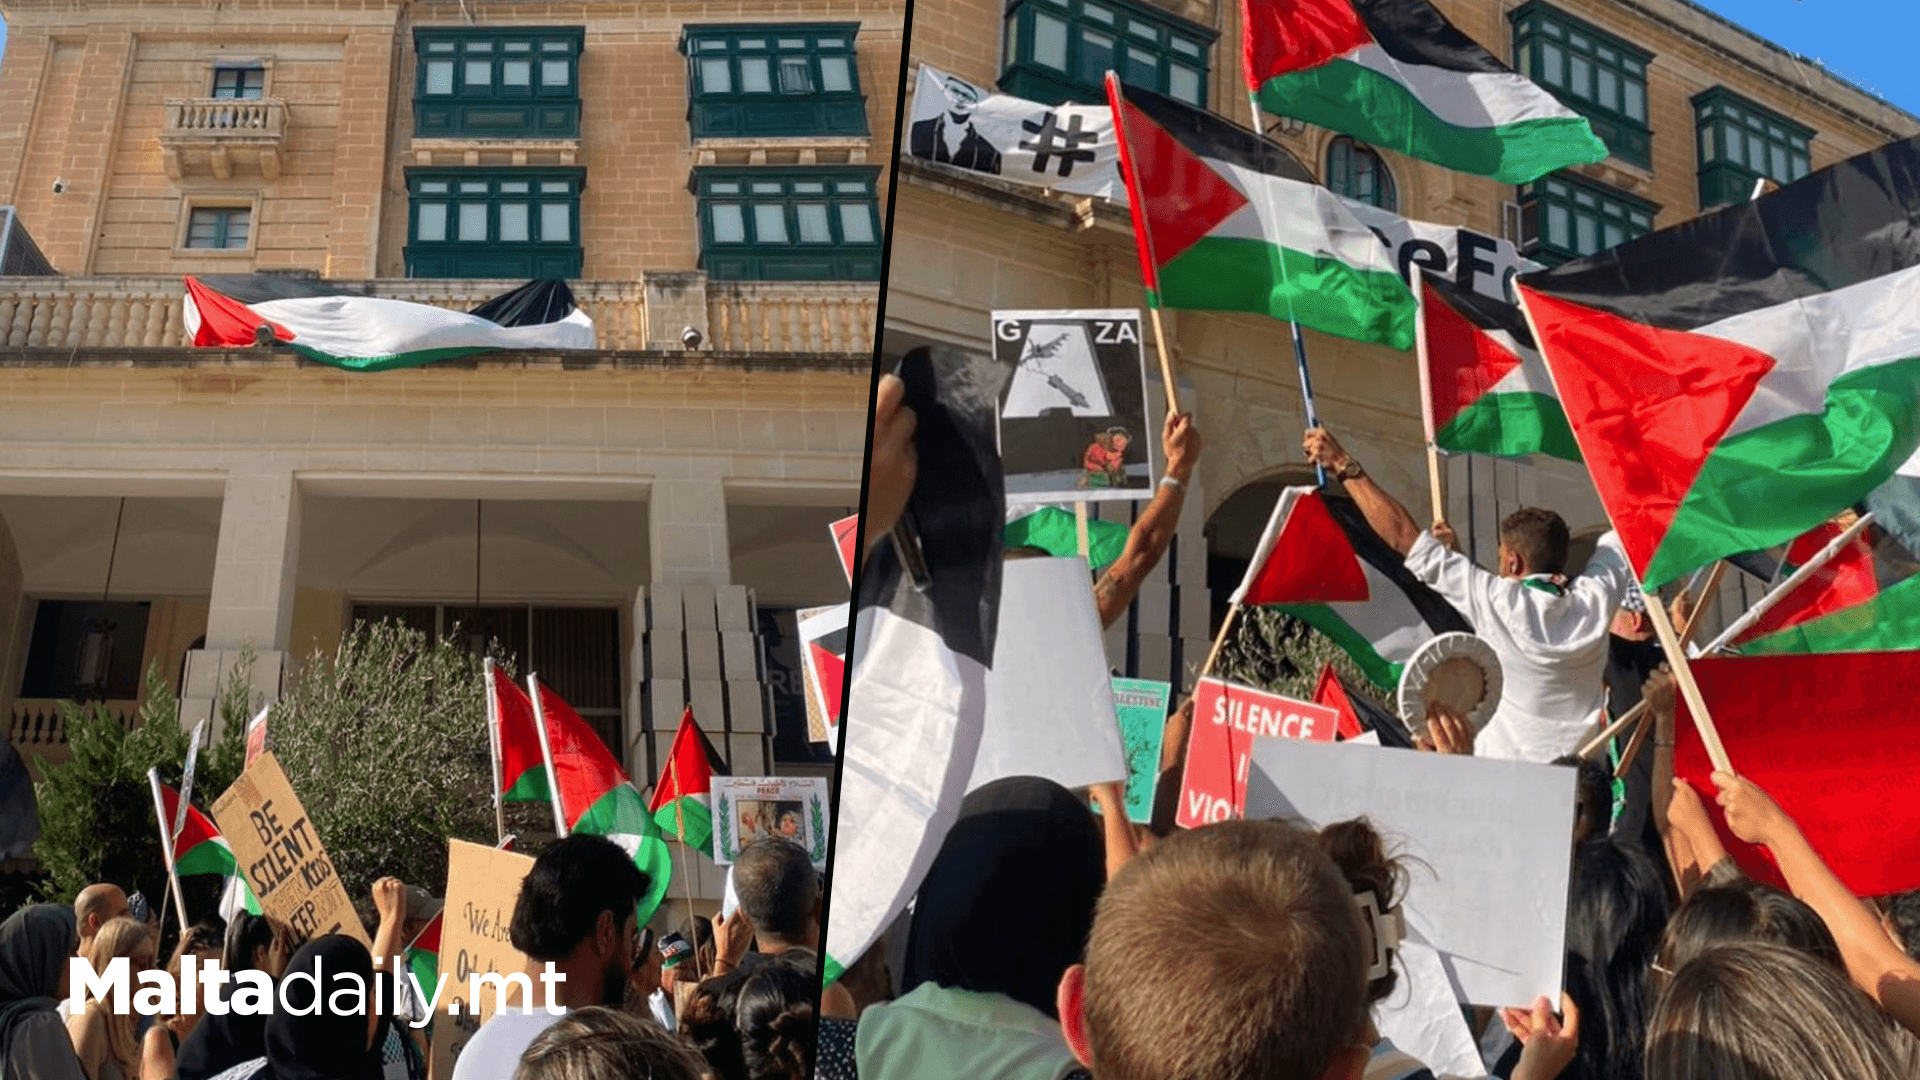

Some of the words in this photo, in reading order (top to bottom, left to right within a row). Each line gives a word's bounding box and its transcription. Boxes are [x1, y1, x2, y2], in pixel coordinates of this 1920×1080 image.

[1212, 695, 1315, 739] SILENCE
[1237, 753, 1249, 783] I
[250, 799, 283, 846] BE
[250, 817, 313, 898] SILENT
[299, 850, 332, 891] KIDS
[463, 901, 490, 938] We
